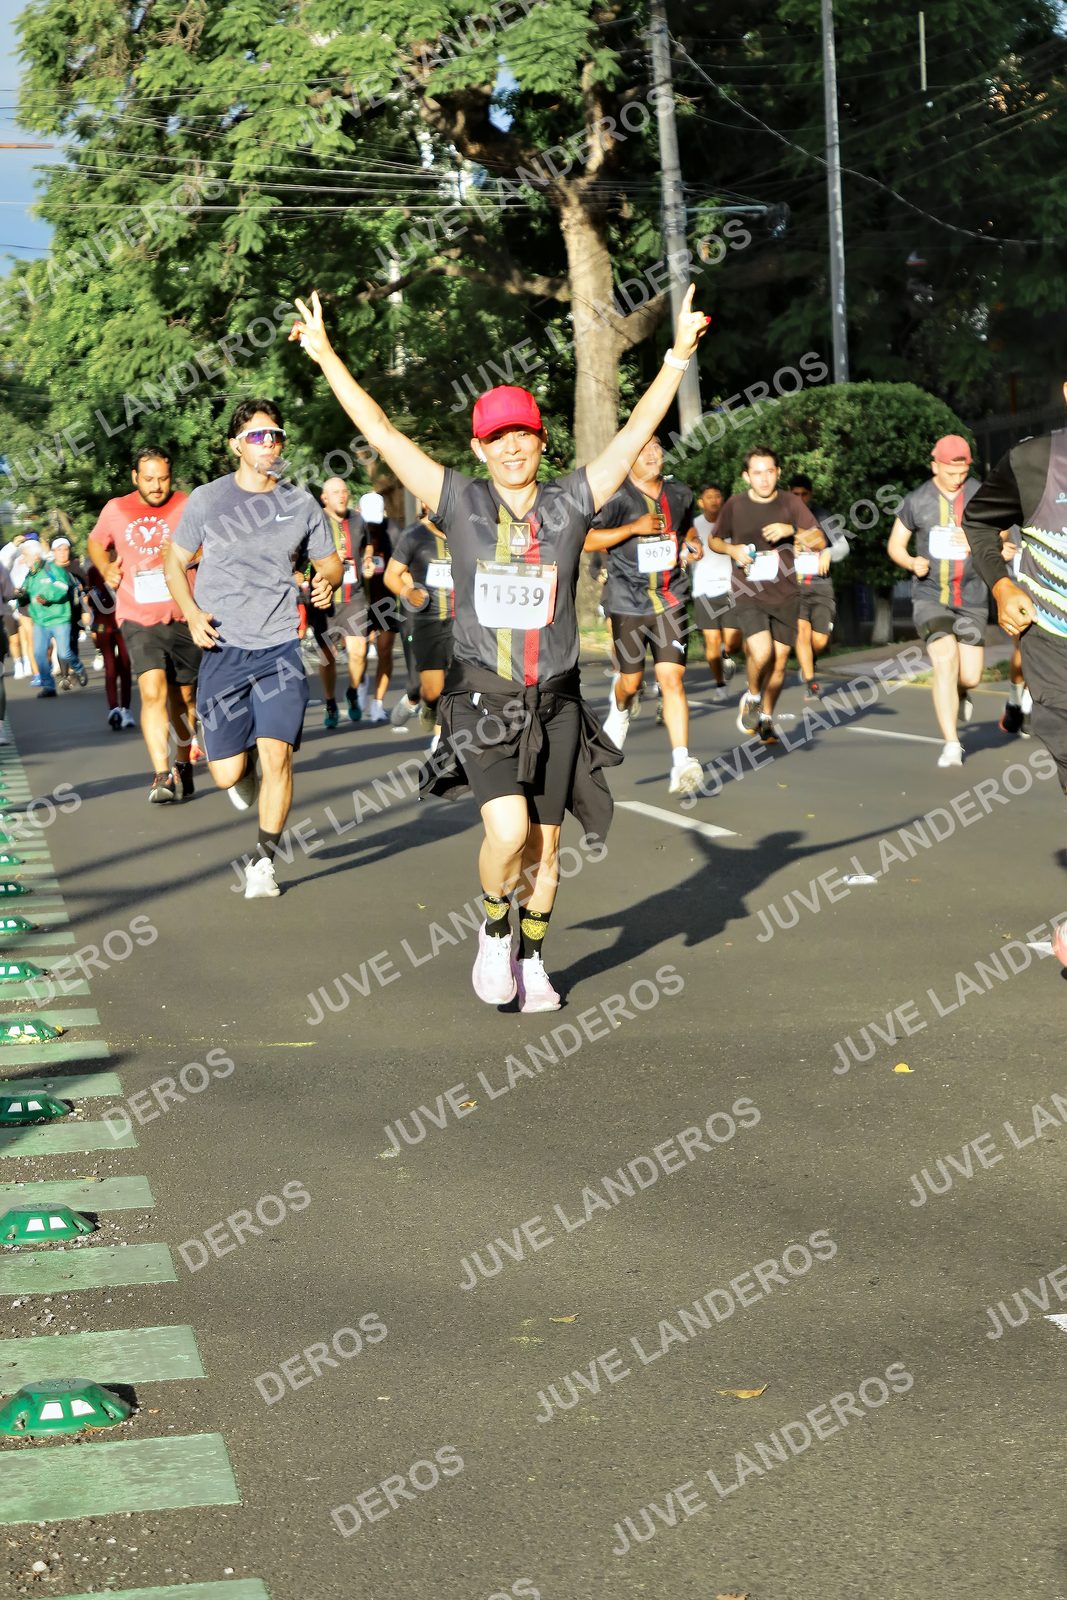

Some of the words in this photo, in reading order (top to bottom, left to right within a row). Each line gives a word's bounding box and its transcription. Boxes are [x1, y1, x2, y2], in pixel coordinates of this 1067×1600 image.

[125, 516, 157, 546] AMERICAN
[139, 546, 160, 555] USA
[645, 545, 671, 558] 9679
[480, 583, 544, 606] 11539
